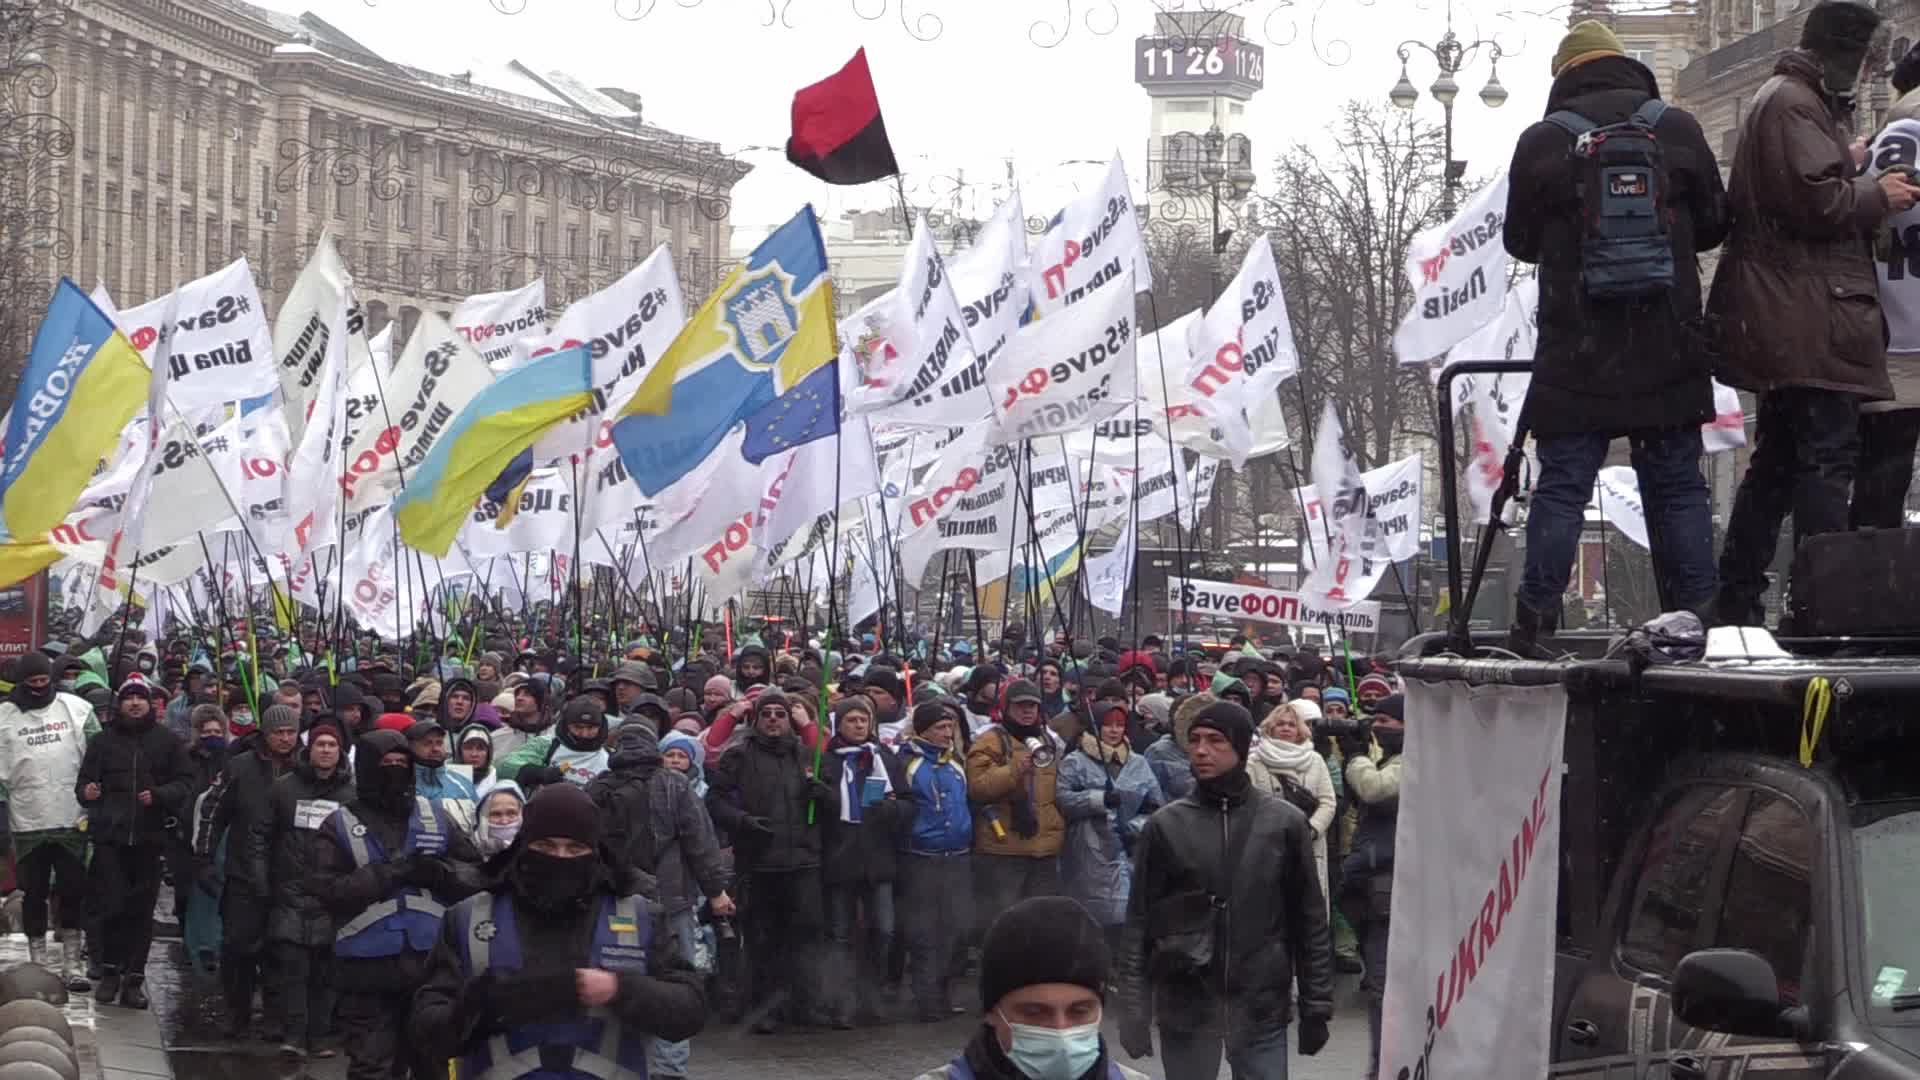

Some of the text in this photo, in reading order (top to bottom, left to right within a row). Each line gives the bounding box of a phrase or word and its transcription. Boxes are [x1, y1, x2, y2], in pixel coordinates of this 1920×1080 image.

[1143, 46, 1224, 76] 11 26
[27, 733, 62, 747] ОДЕСА
